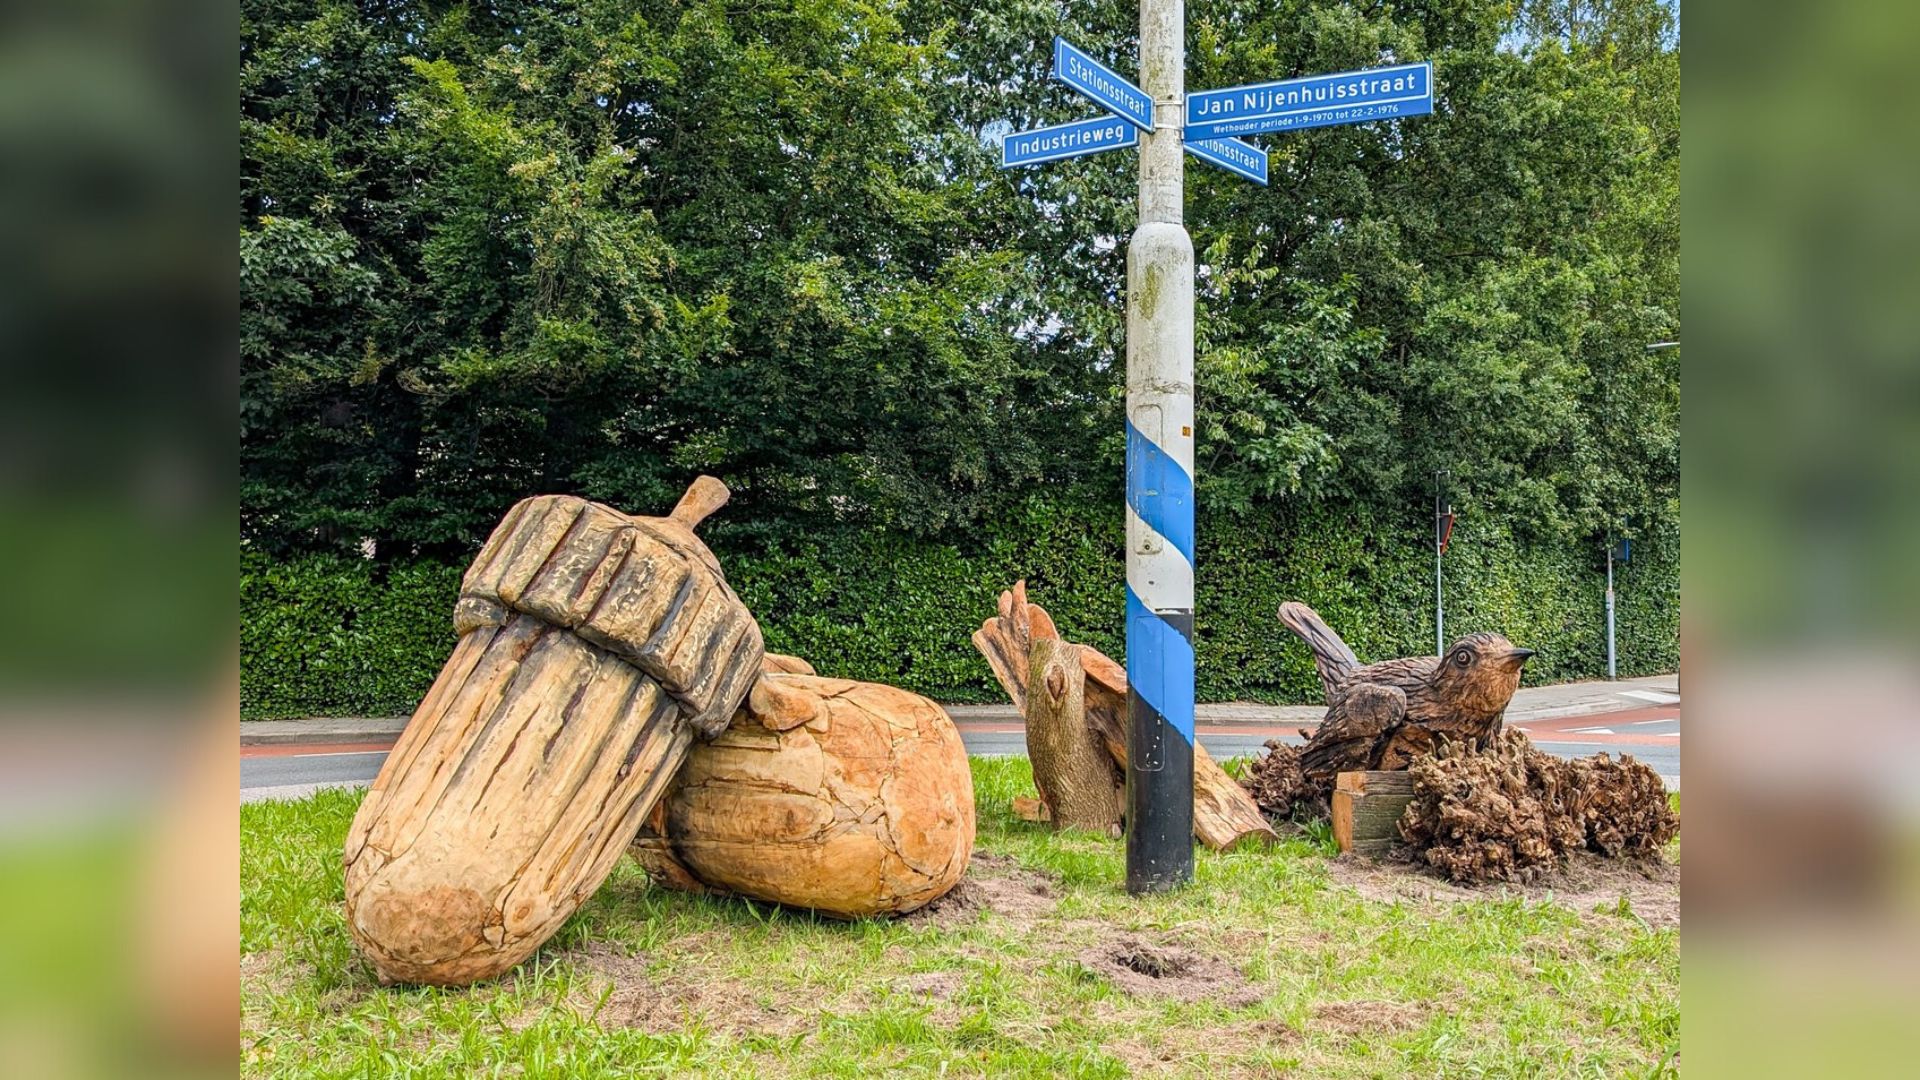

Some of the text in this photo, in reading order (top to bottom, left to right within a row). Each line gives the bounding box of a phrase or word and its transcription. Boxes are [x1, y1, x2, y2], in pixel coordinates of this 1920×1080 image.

[1069, 56, 1145, 117] Stationsstraat
[1197, 73, 1415, 116] Jan Nijenhuisstraat
[1213, 103, 1399, 134] Wethouder periode 1-9-1970 tot 22-2-1976
[1015, 124, 1124, 156] Industrieweg
